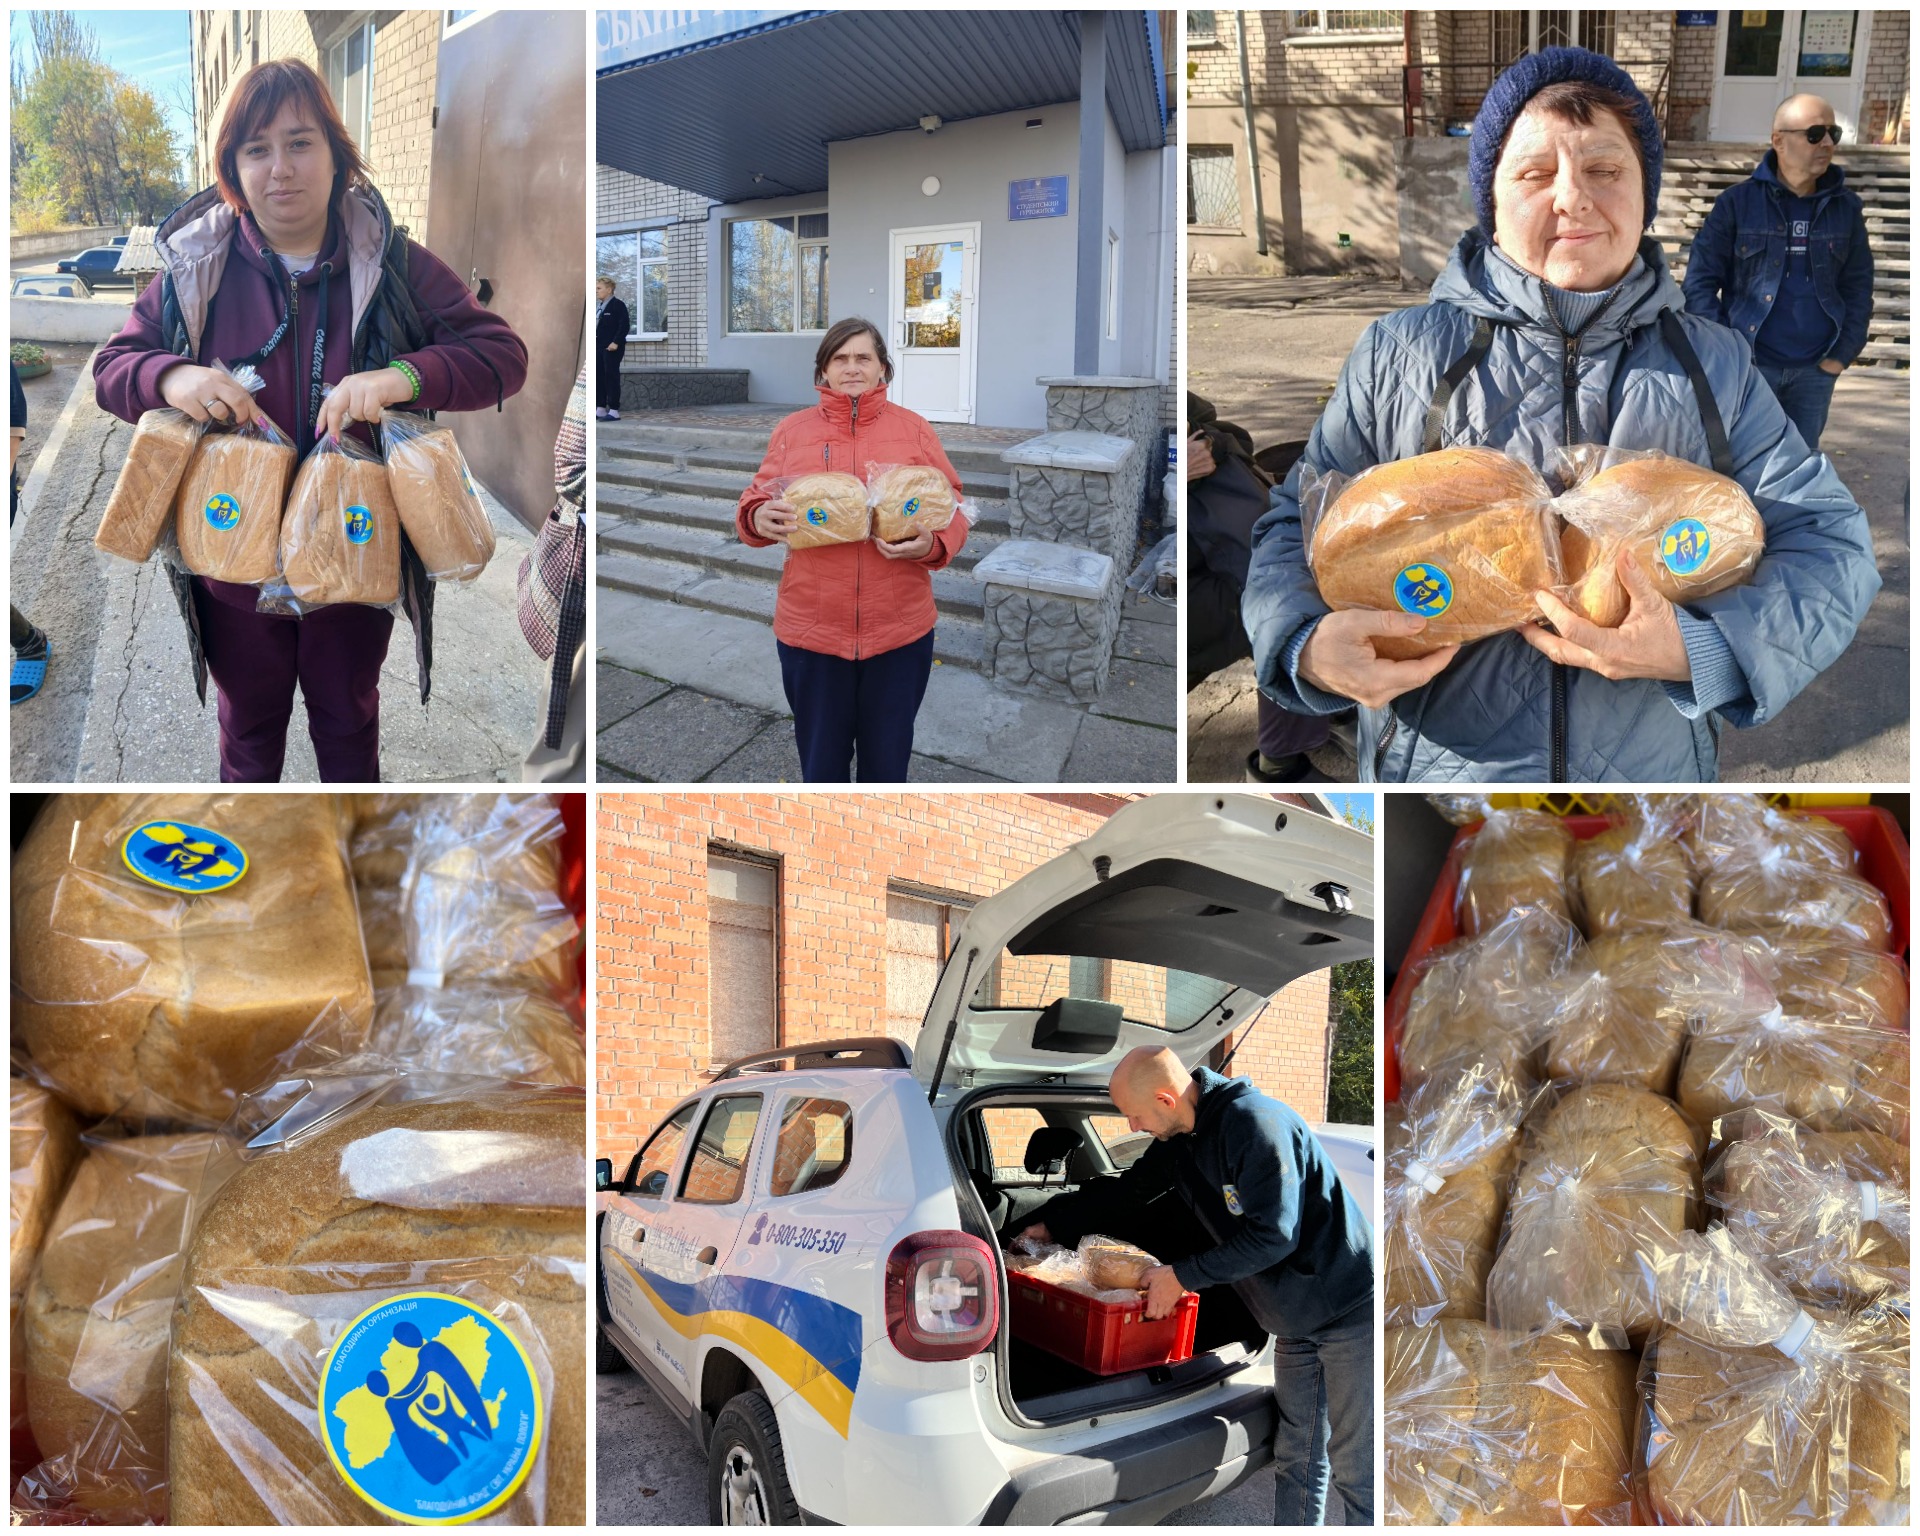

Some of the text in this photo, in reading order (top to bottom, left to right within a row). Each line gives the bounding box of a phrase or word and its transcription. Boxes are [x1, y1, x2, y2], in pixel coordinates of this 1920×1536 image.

[311, 328, 325, 380] couture
[765, 1222, 847, 1255] 0-800-305-350
[333, 1301, 418, 1373] БЛАГОДІЙНА ОРГАНІЗАЦІЯ
